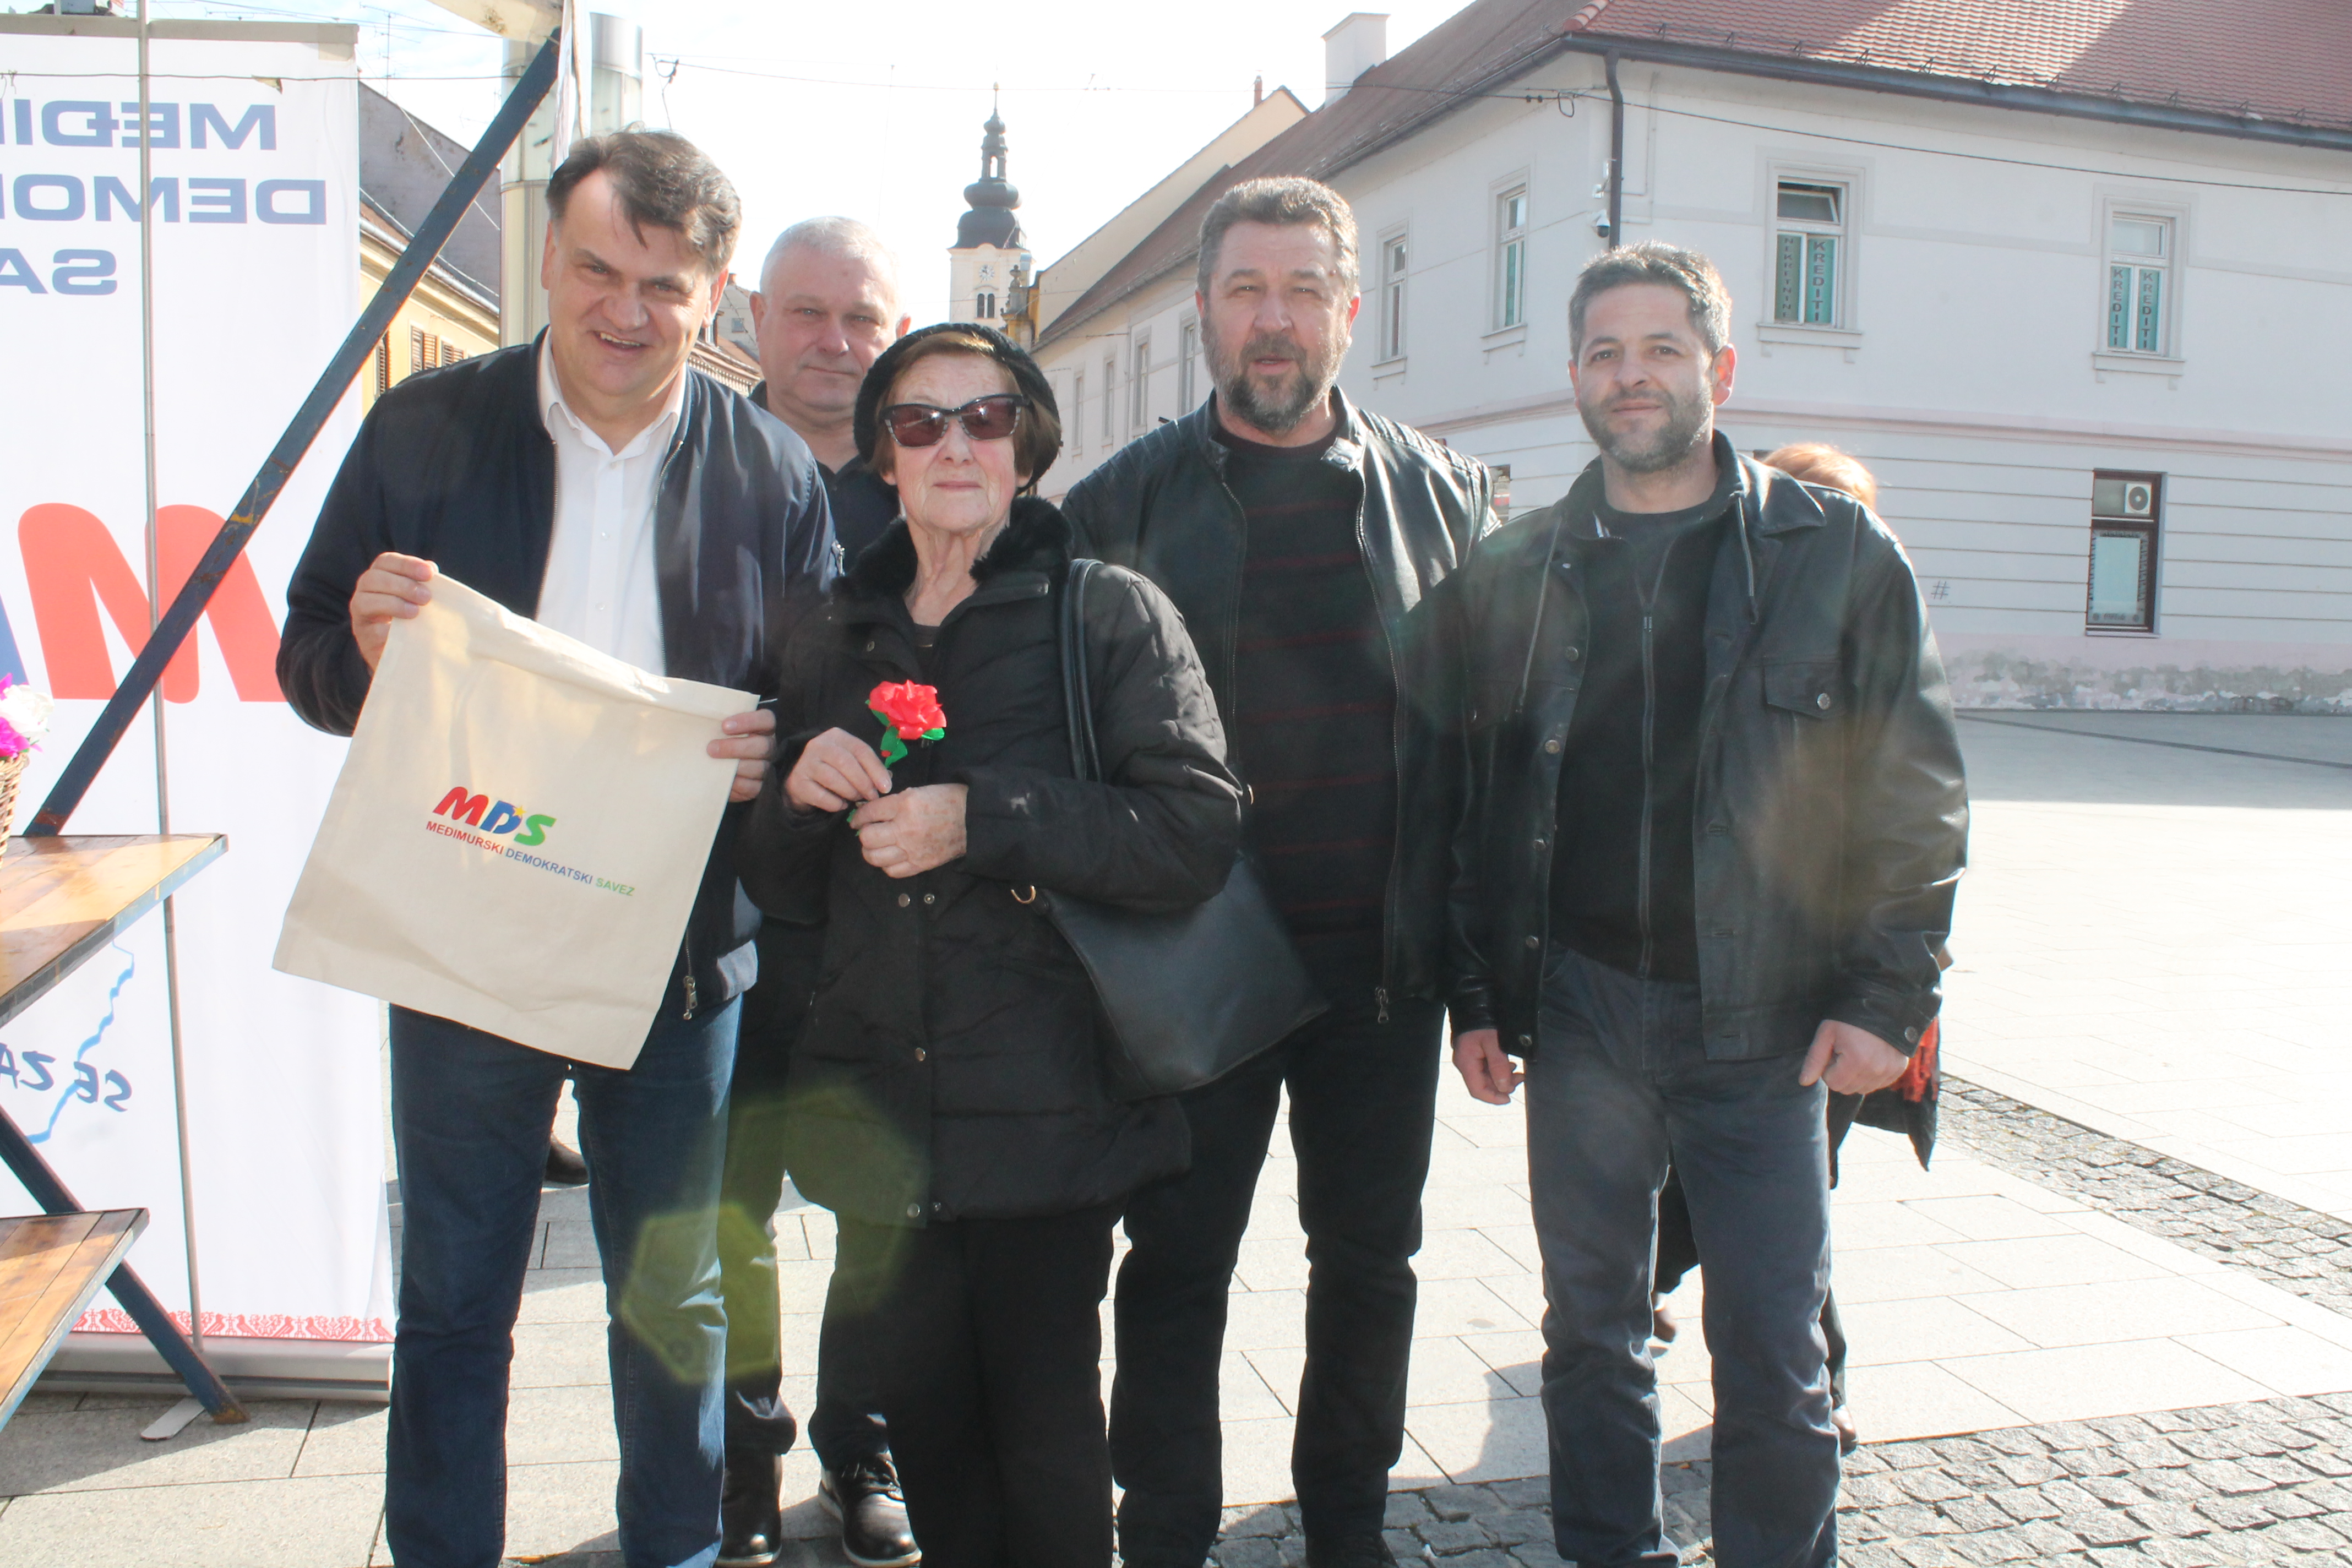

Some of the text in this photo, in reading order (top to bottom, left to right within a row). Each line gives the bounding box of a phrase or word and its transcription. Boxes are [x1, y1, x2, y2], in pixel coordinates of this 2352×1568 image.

[1812, 241, 1826, 322] KREDITI
[2111, 269, 2124, 346] KREDITI
[2142, 273, 2153, 349] KREDITI
[432, 786, 557, 846] MDS
[426, 821, 635, 896] MEĐIMURSKI DEMOKRATSKI SAVEZ
